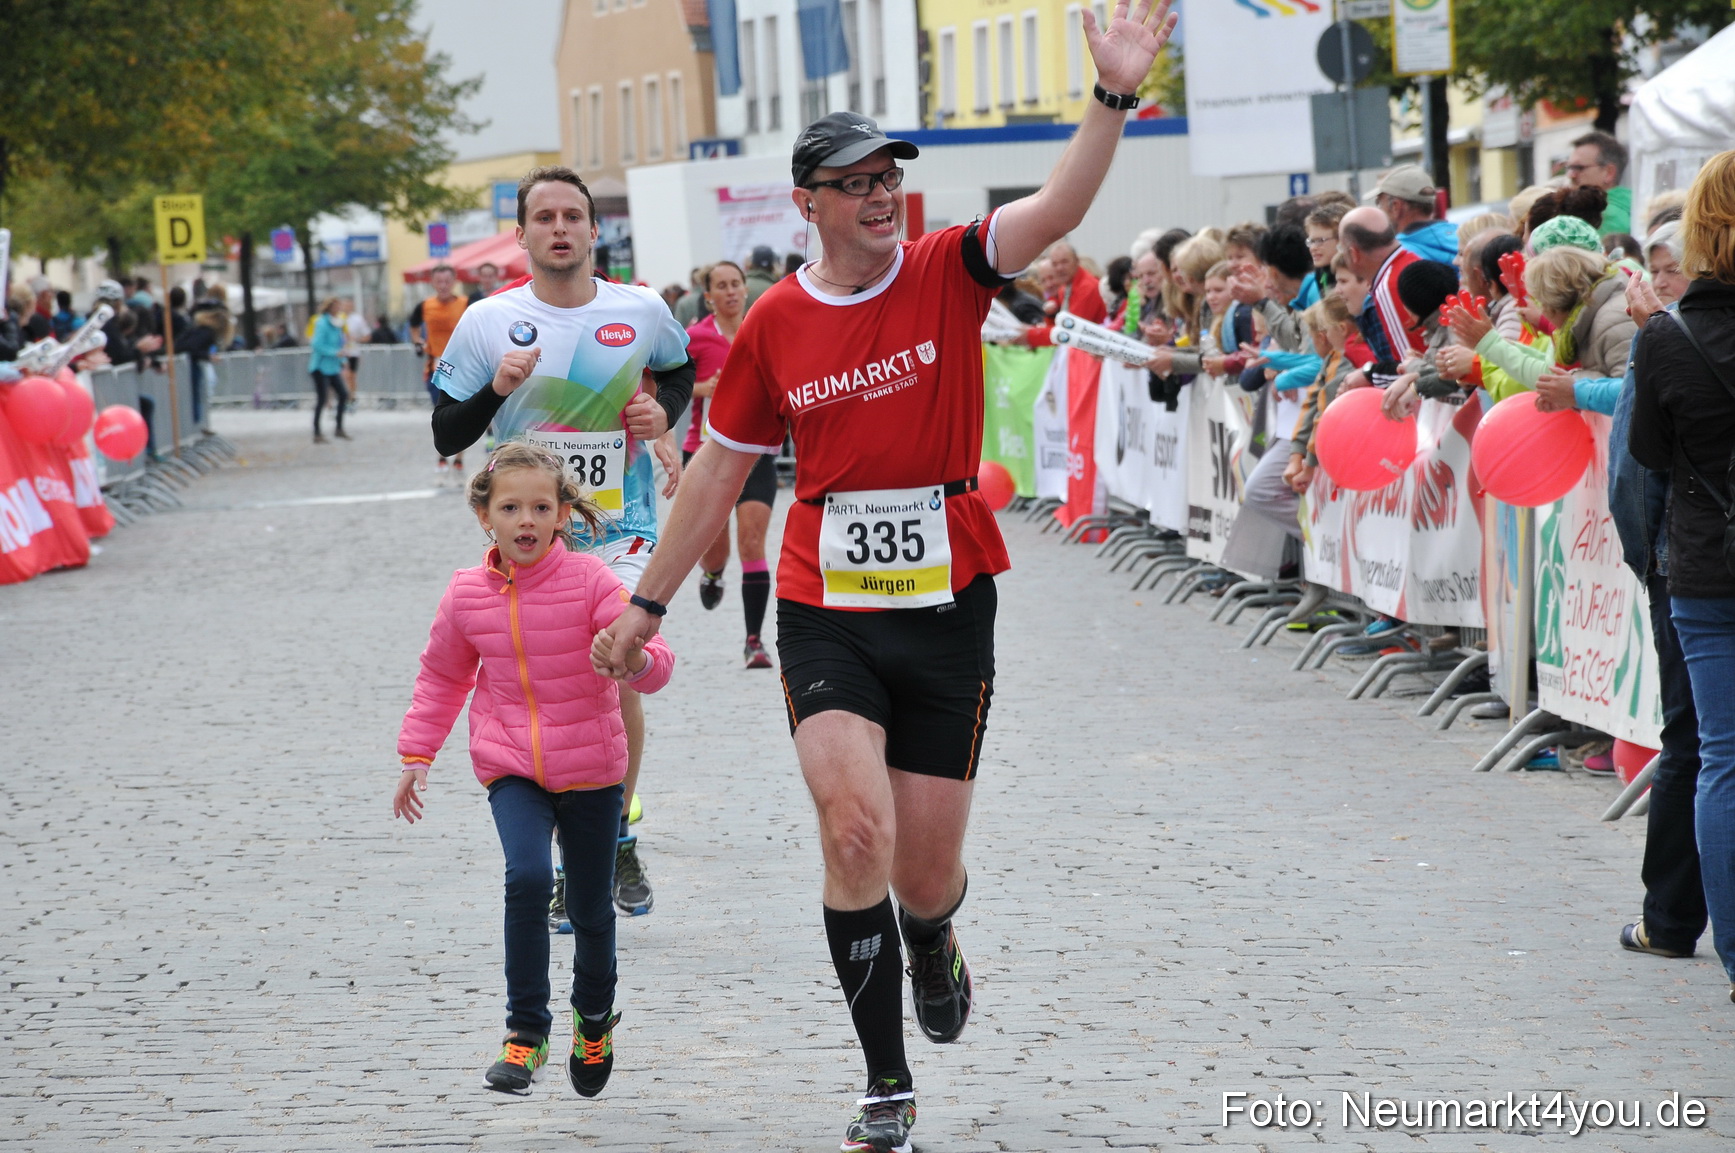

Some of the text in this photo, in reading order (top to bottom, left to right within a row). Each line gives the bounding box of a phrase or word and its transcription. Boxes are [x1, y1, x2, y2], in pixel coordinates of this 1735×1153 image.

[170, 217, 192, 248] D
[600, 329, 632, 342] Hervis
[787, 349, 911, 411] NEUMARKT
[863, 376, 919, 402] STARKE STADT
[529, 439, 610, 450] PARTL Neumarkt
[556, 454, 607, 487] 38
[827, 501, 925, 516] PARTL Neumarkt
[846, 519, 925, 565] 335
[860, 576, 915, 595] Jürgen
